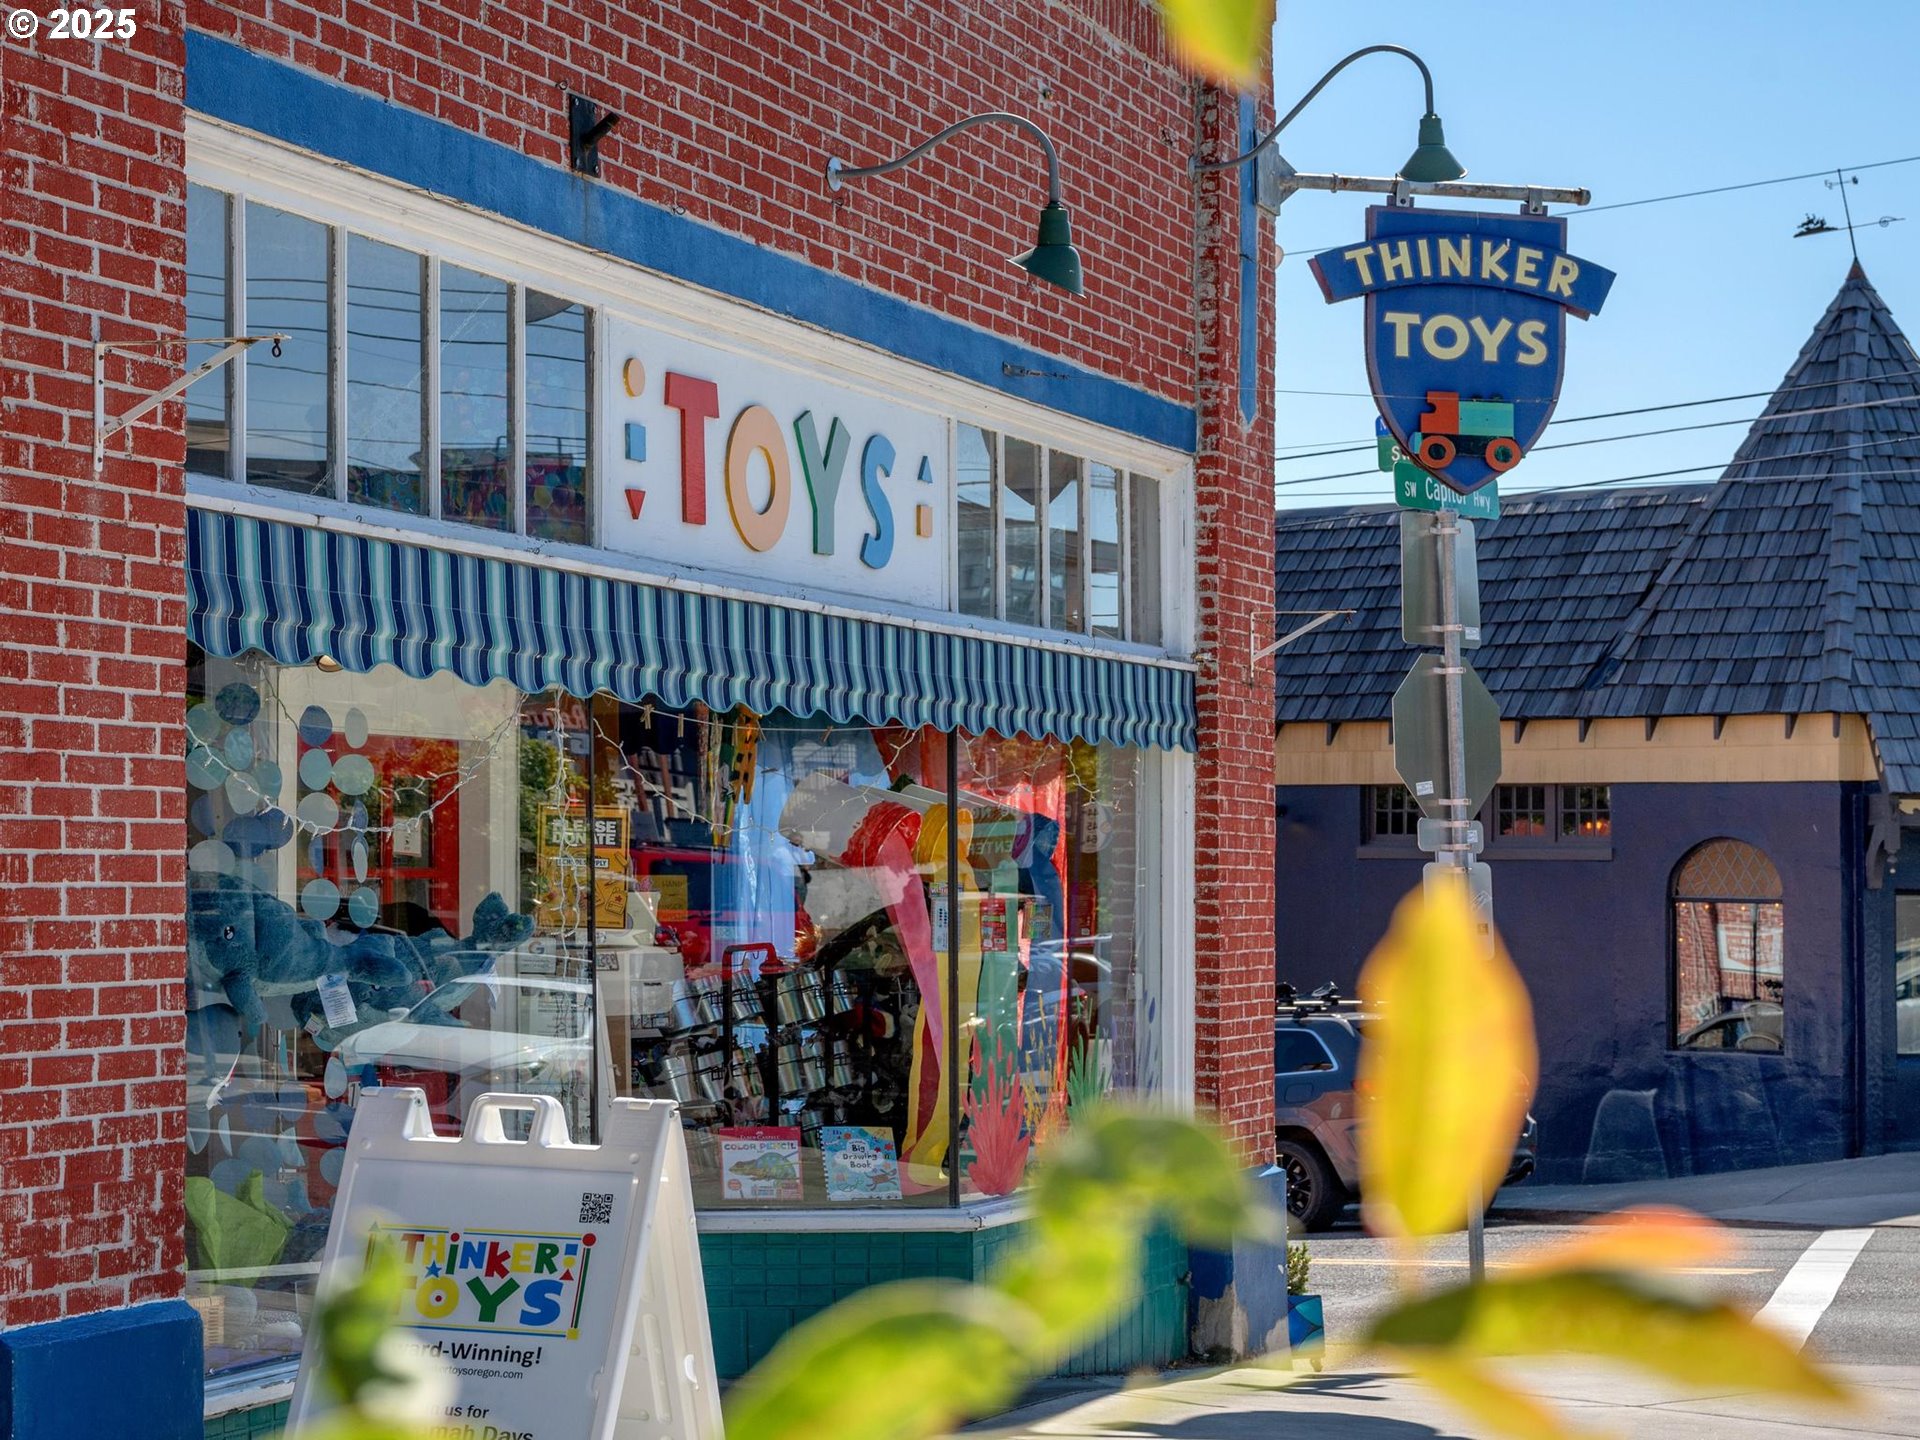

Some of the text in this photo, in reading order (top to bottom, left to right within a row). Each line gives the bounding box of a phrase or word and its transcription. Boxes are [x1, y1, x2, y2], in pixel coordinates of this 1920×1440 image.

[1344, 238, 1579, 297] THINKER
[1384, 312, 1548, 366] TOYS
[664, 371, 896, 570] TOYS
[1404, 480, 1417, 498] SW
[1473, 491, 1491, 512] Hwy
[552, 819, 617, 833] PLESE
[552, 831, 617, 845] DONTE
[724, 1143, 756, 1151] COLOR
[851, 1144, 866, 1153] Big
[842, 1152, 878, 1161] Drawing
[849, 1160, 872, 1169] Book
[445, 1405, 463, 1417] us
[467, 1404, 490, 1419] for
